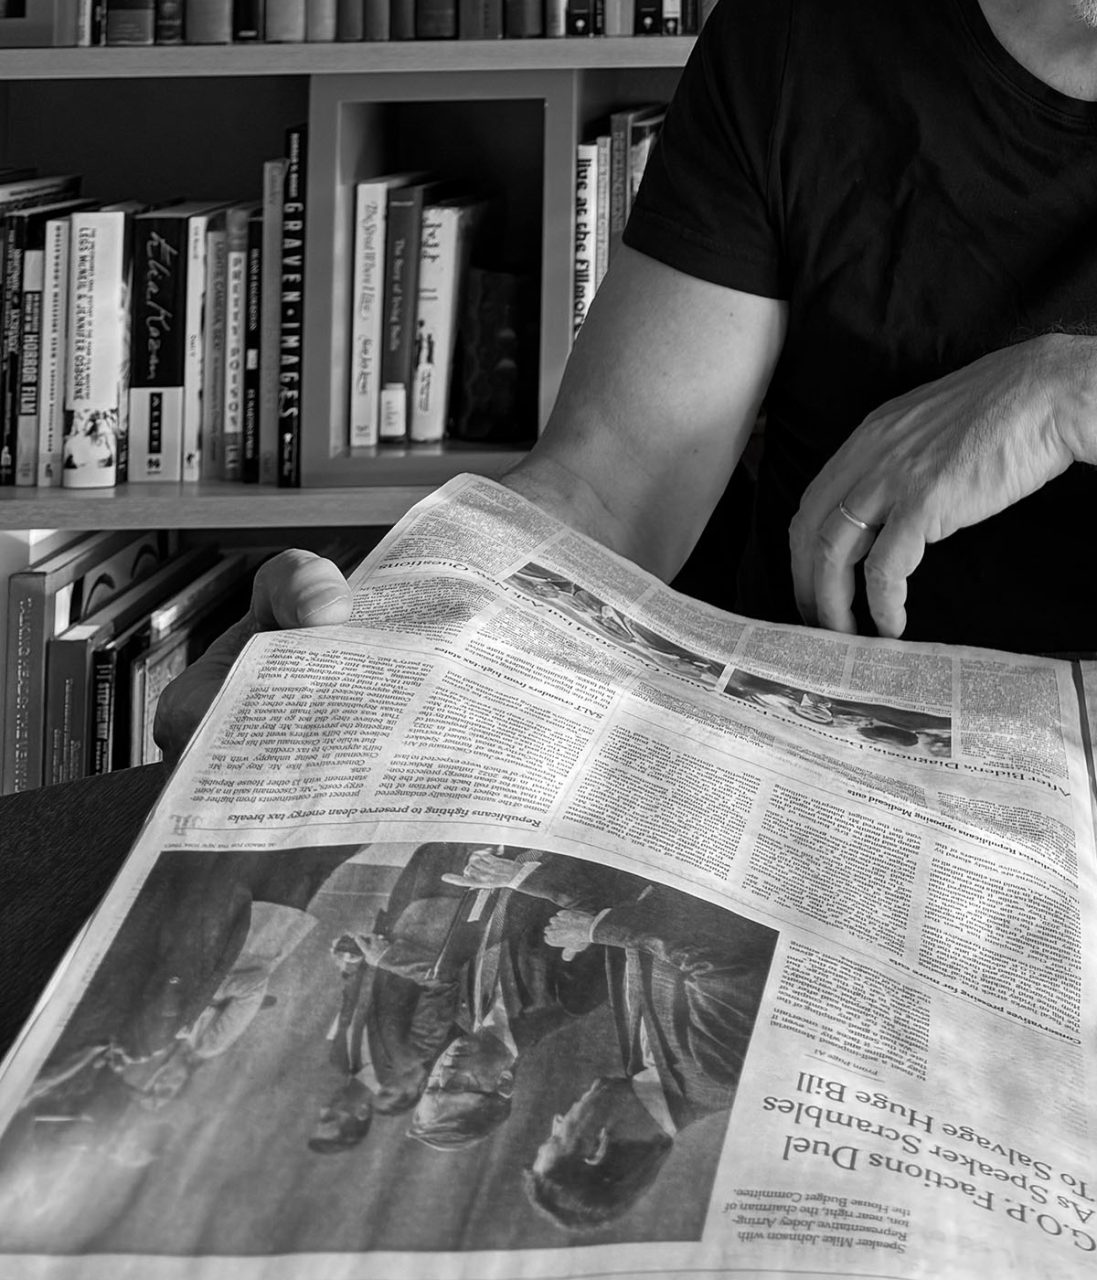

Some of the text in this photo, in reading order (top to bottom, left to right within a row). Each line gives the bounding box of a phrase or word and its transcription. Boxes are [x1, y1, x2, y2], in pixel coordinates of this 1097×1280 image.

[278, 201, 303, 418] GRAVEN IMAGES
[20, 335, 37, 415] HORROR FILM
[227, 805, 541, 828] Republicans fighting to preserve clean energy tax breaks
[761, 1096, 1097, 1223] As Speaker Scrambles
[782, 1133, 1097, 1252] G.O.P. Factions Duel
[795, 1070, 1096, 1202] To Salvage Huge Bill
